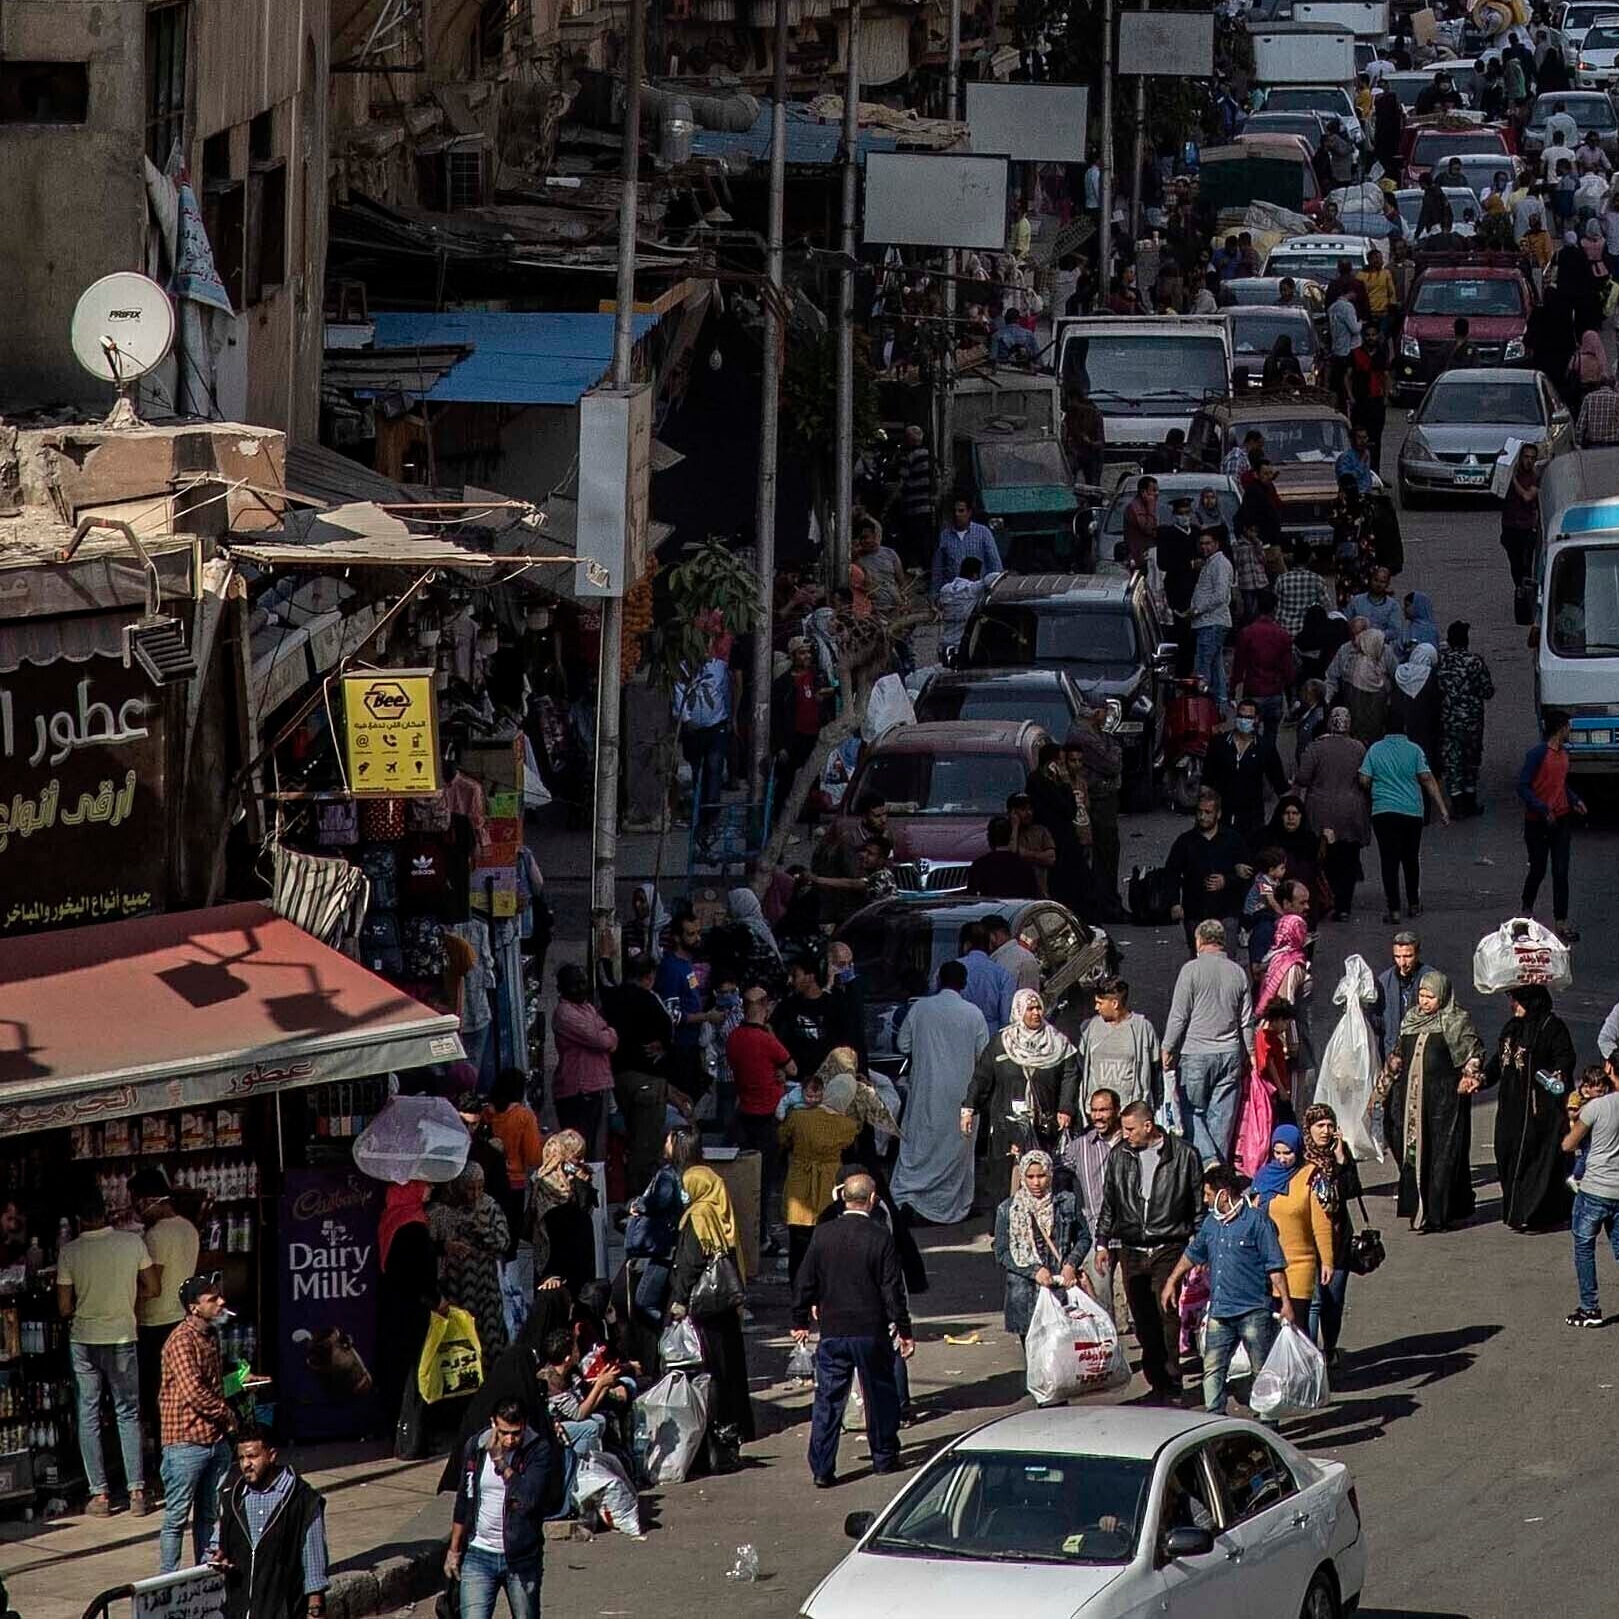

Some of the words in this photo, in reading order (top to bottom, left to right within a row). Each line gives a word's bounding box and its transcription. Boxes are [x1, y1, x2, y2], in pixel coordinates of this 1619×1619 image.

[373, 693, 405, 709] Bee
[28, 680, 149, 769] عطور
[50, 893, 92, 922] البخور
[92, 888, 122, 918] أنواع
[122, 891, 152, 916] جميع
[289, 1242, 371, 1274] Dairy
[293, 1272, 369, 1301] Milk
